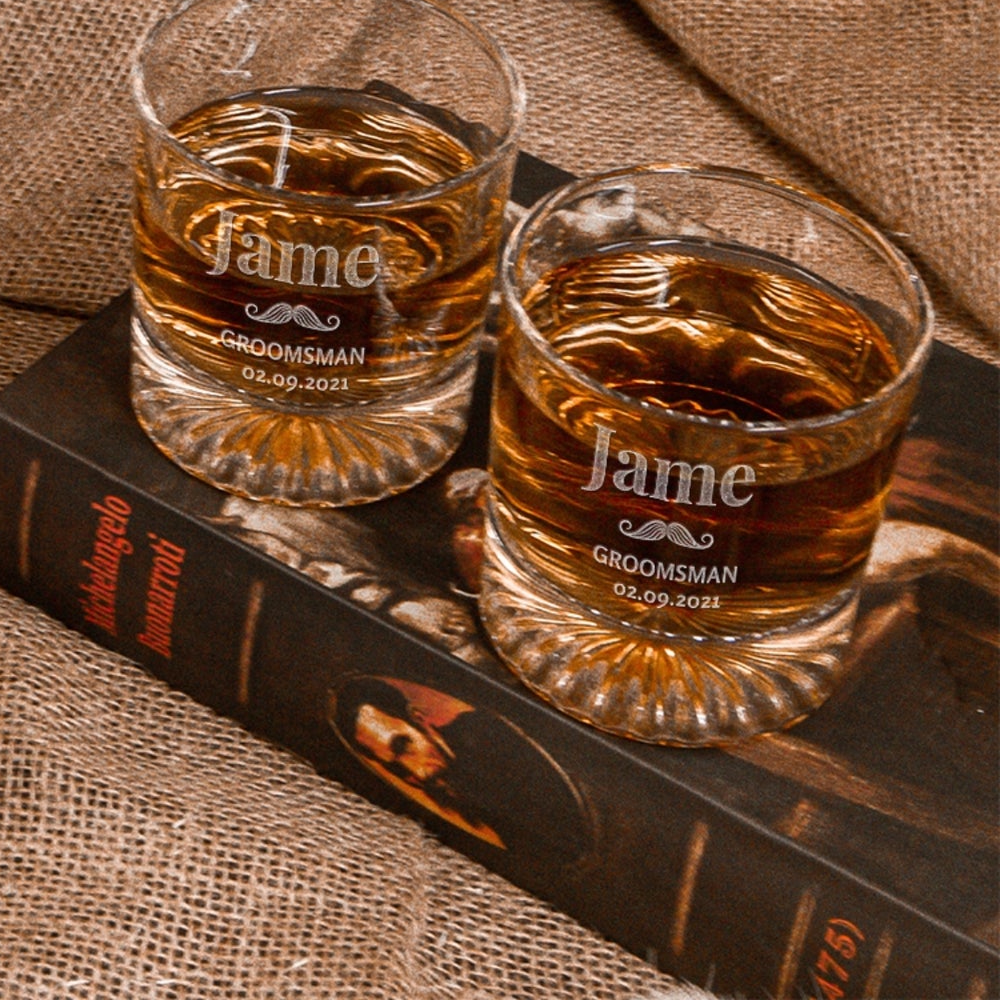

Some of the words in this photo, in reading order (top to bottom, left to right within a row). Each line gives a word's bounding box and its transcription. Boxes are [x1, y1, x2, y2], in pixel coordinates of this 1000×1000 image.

[205, 210, 380, 288] Jame
[220, 329, 366, 367] GROOMSMAN
[242, 367, 350, 393] 02.09.2021
[581, 422, 757, 508] Jame
[78, 494, 134, 636] Michelangelo
[137, 531, 187, 659] Buonarroti
[593, 544, 739, 584] GROOMSMAN
[613, 582, 721, 609] 02.09.2021
[809, 917, 866, 1000] 475)
